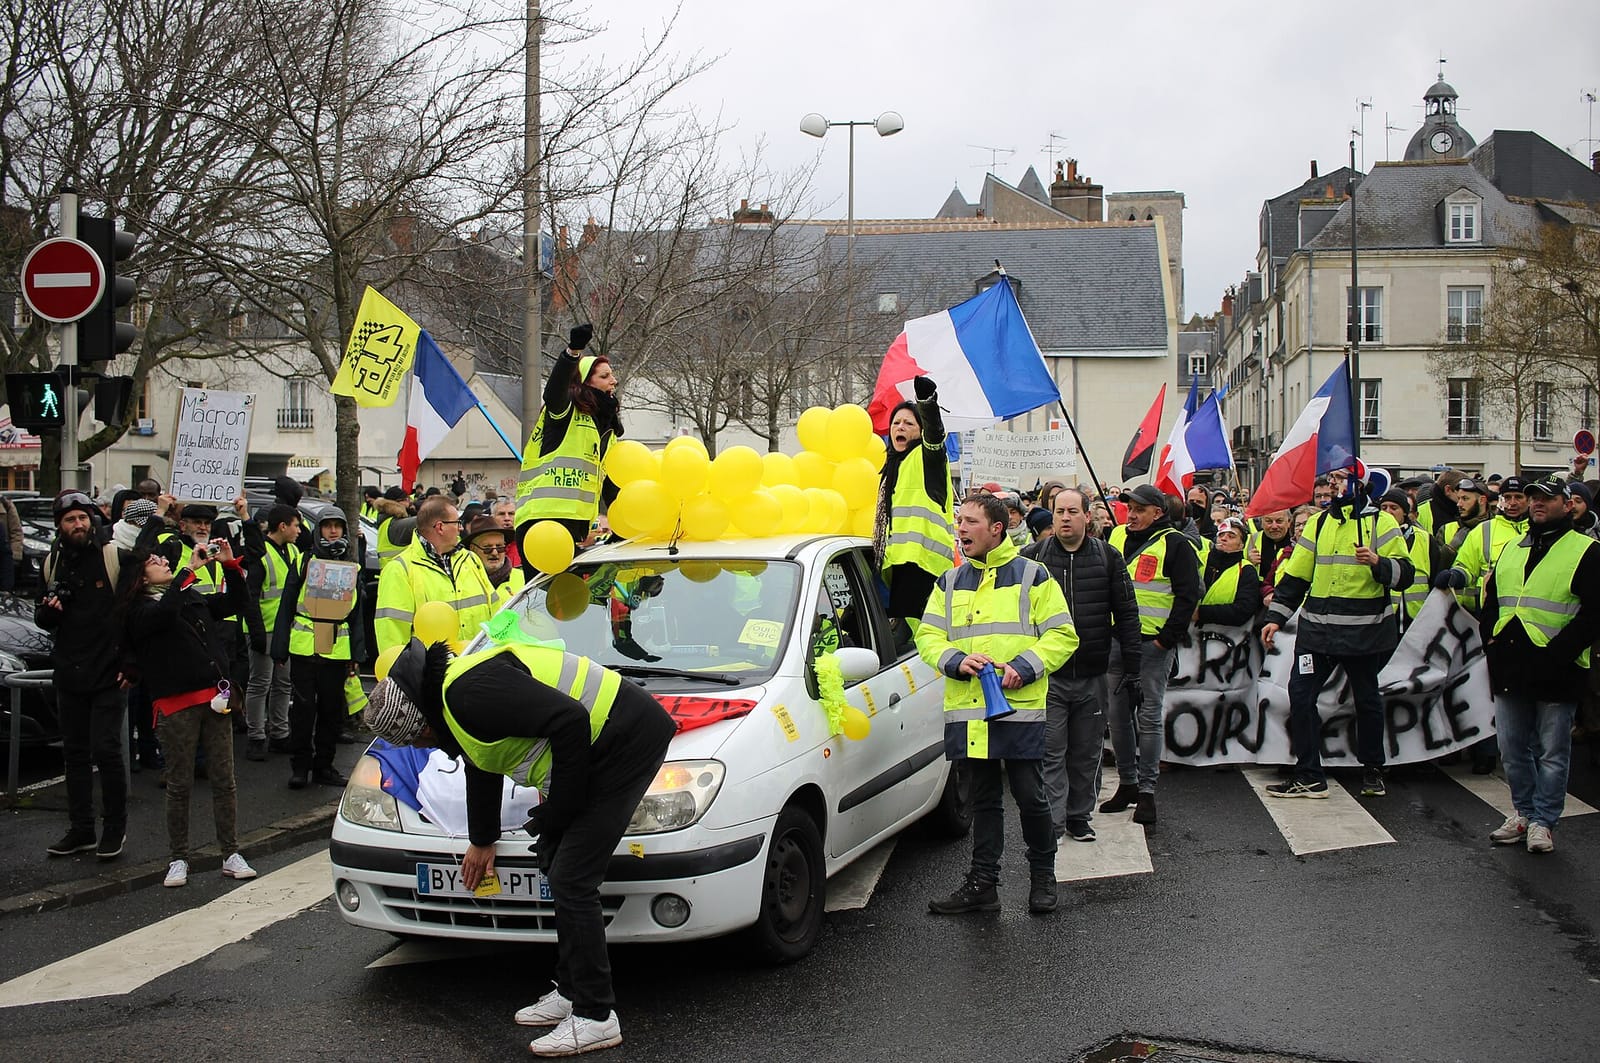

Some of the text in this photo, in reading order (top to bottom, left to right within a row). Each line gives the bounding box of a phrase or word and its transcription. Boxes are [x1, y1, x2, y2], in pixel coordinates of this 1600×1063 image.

[181, 395, 246, 425] Macron
[198, 424, 240, 451] banksters
[192, 458, 222, 475] casse
[290, 459, 320, 468] HALLES
[1020, 461, 1028, 470] ET
[172, 471, 236, 501] France
